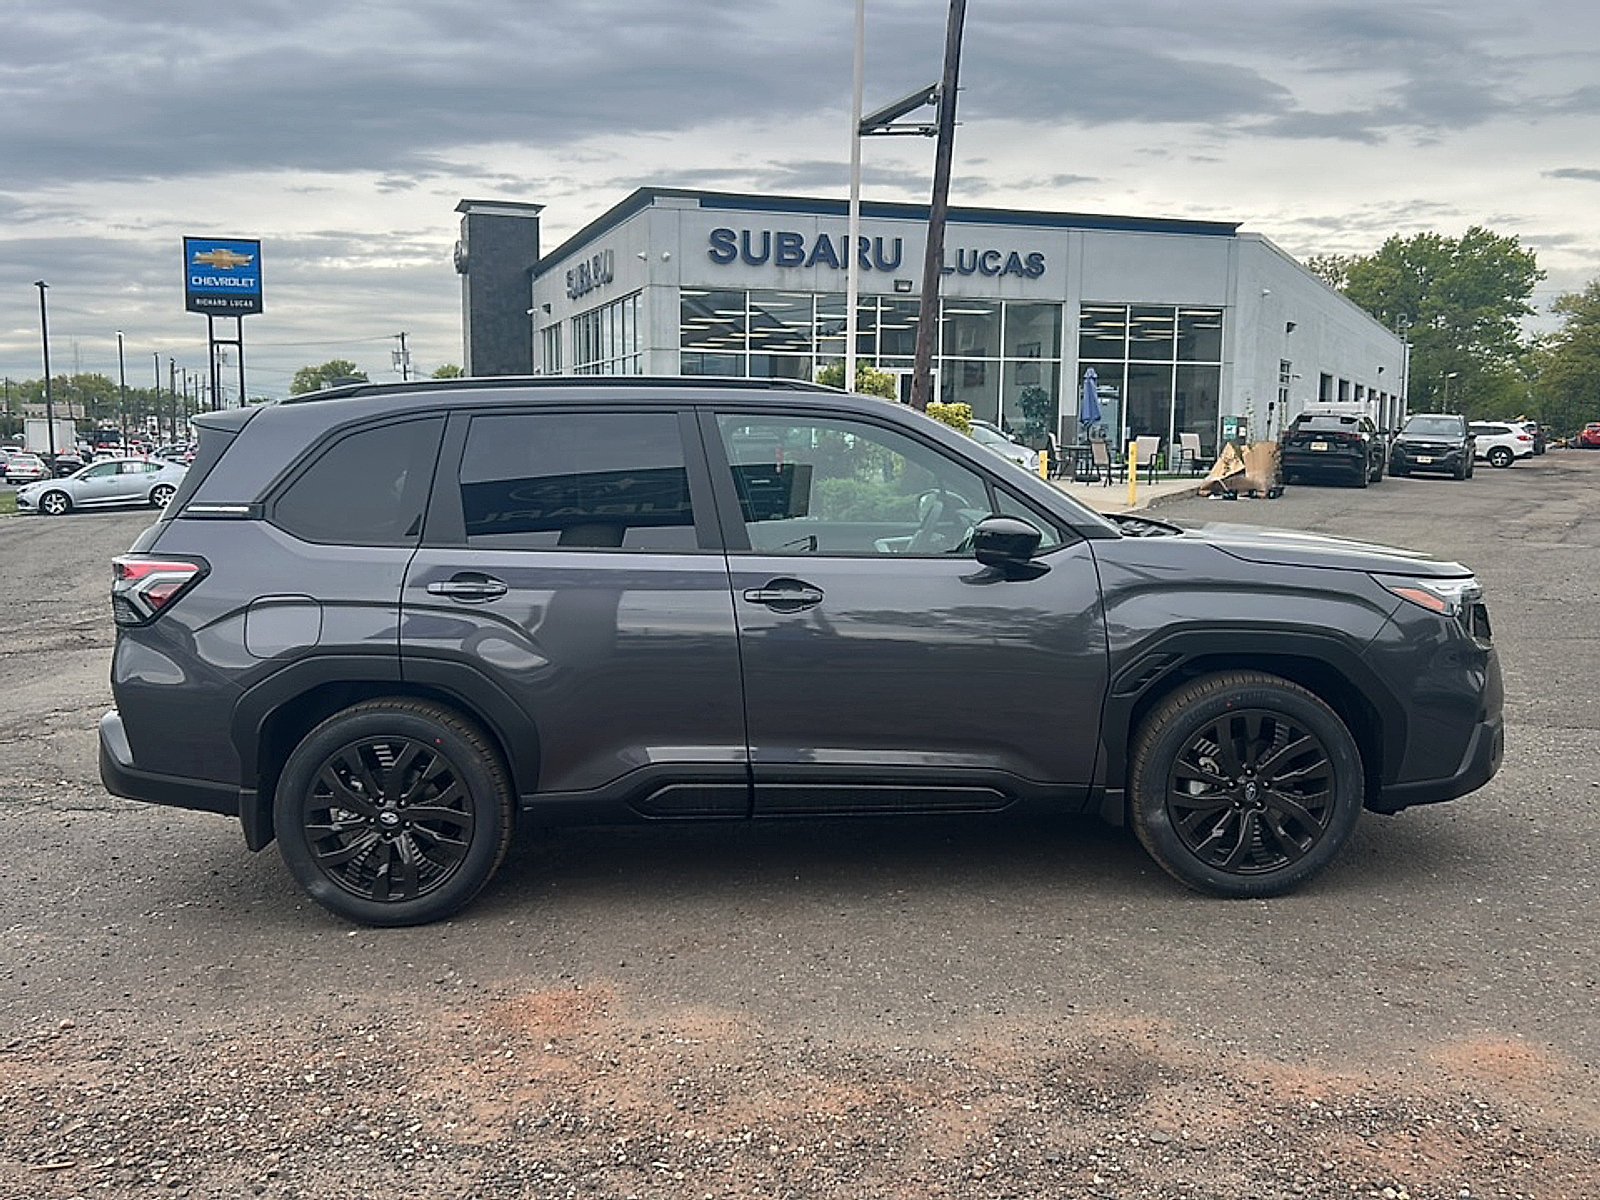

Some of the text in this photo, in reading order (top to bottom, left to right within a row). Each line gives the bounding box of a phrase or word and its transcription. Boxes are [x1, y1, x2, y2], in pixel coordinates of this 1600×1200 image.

[708, 228, 903, 272] SUBARU
[191, 276, 255, 287] CHEVROLET
[196, 298, 253, 308] RICHARD LUCAS
